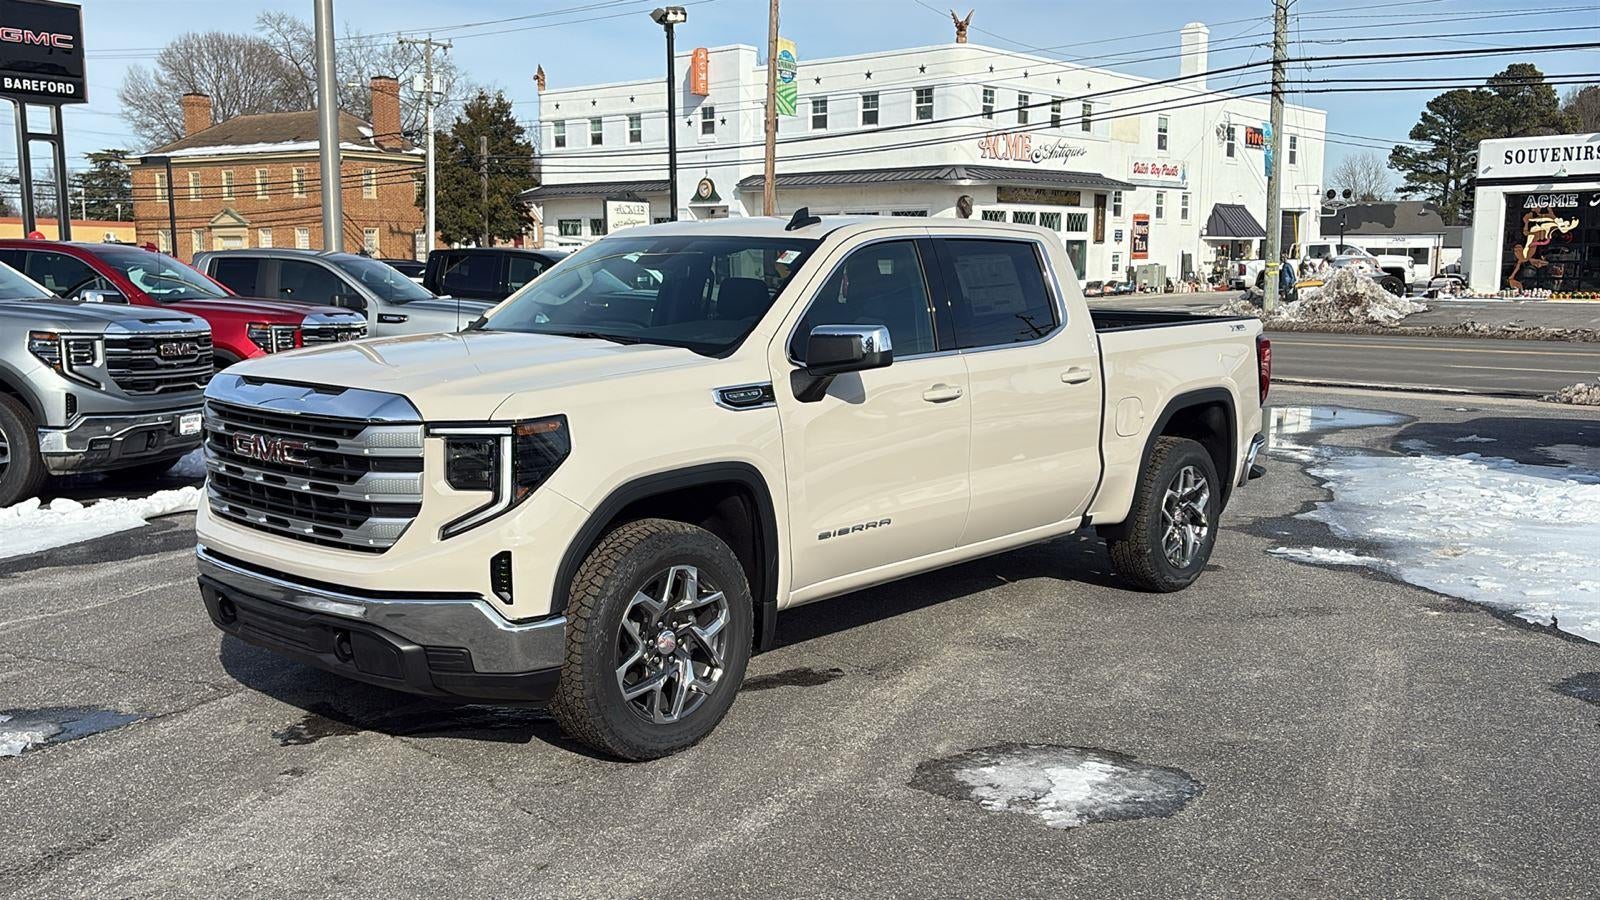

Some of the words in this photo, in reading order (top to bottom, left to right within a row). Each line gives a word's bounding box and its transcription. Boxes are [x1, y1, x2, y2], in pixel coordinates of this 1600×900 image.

[0, 27, 74, 49] GMC
[3, 77, 75, 94] BAREFORD
[978, 131, 1032, 162] ACME
[1041, 136, 1087, 166] Antiques
[1133, 161, 1149, 175] Dutch
[1150, 162, 1161, 178] Boy
[1161, 163, 1179, 177] Paints
[1523, 193, 1579, 209] ACME
[160, 343, 199, 357] GMC
[233, 431, 309, 467] GMC
[818, 518, 892, 541] SIERRA
